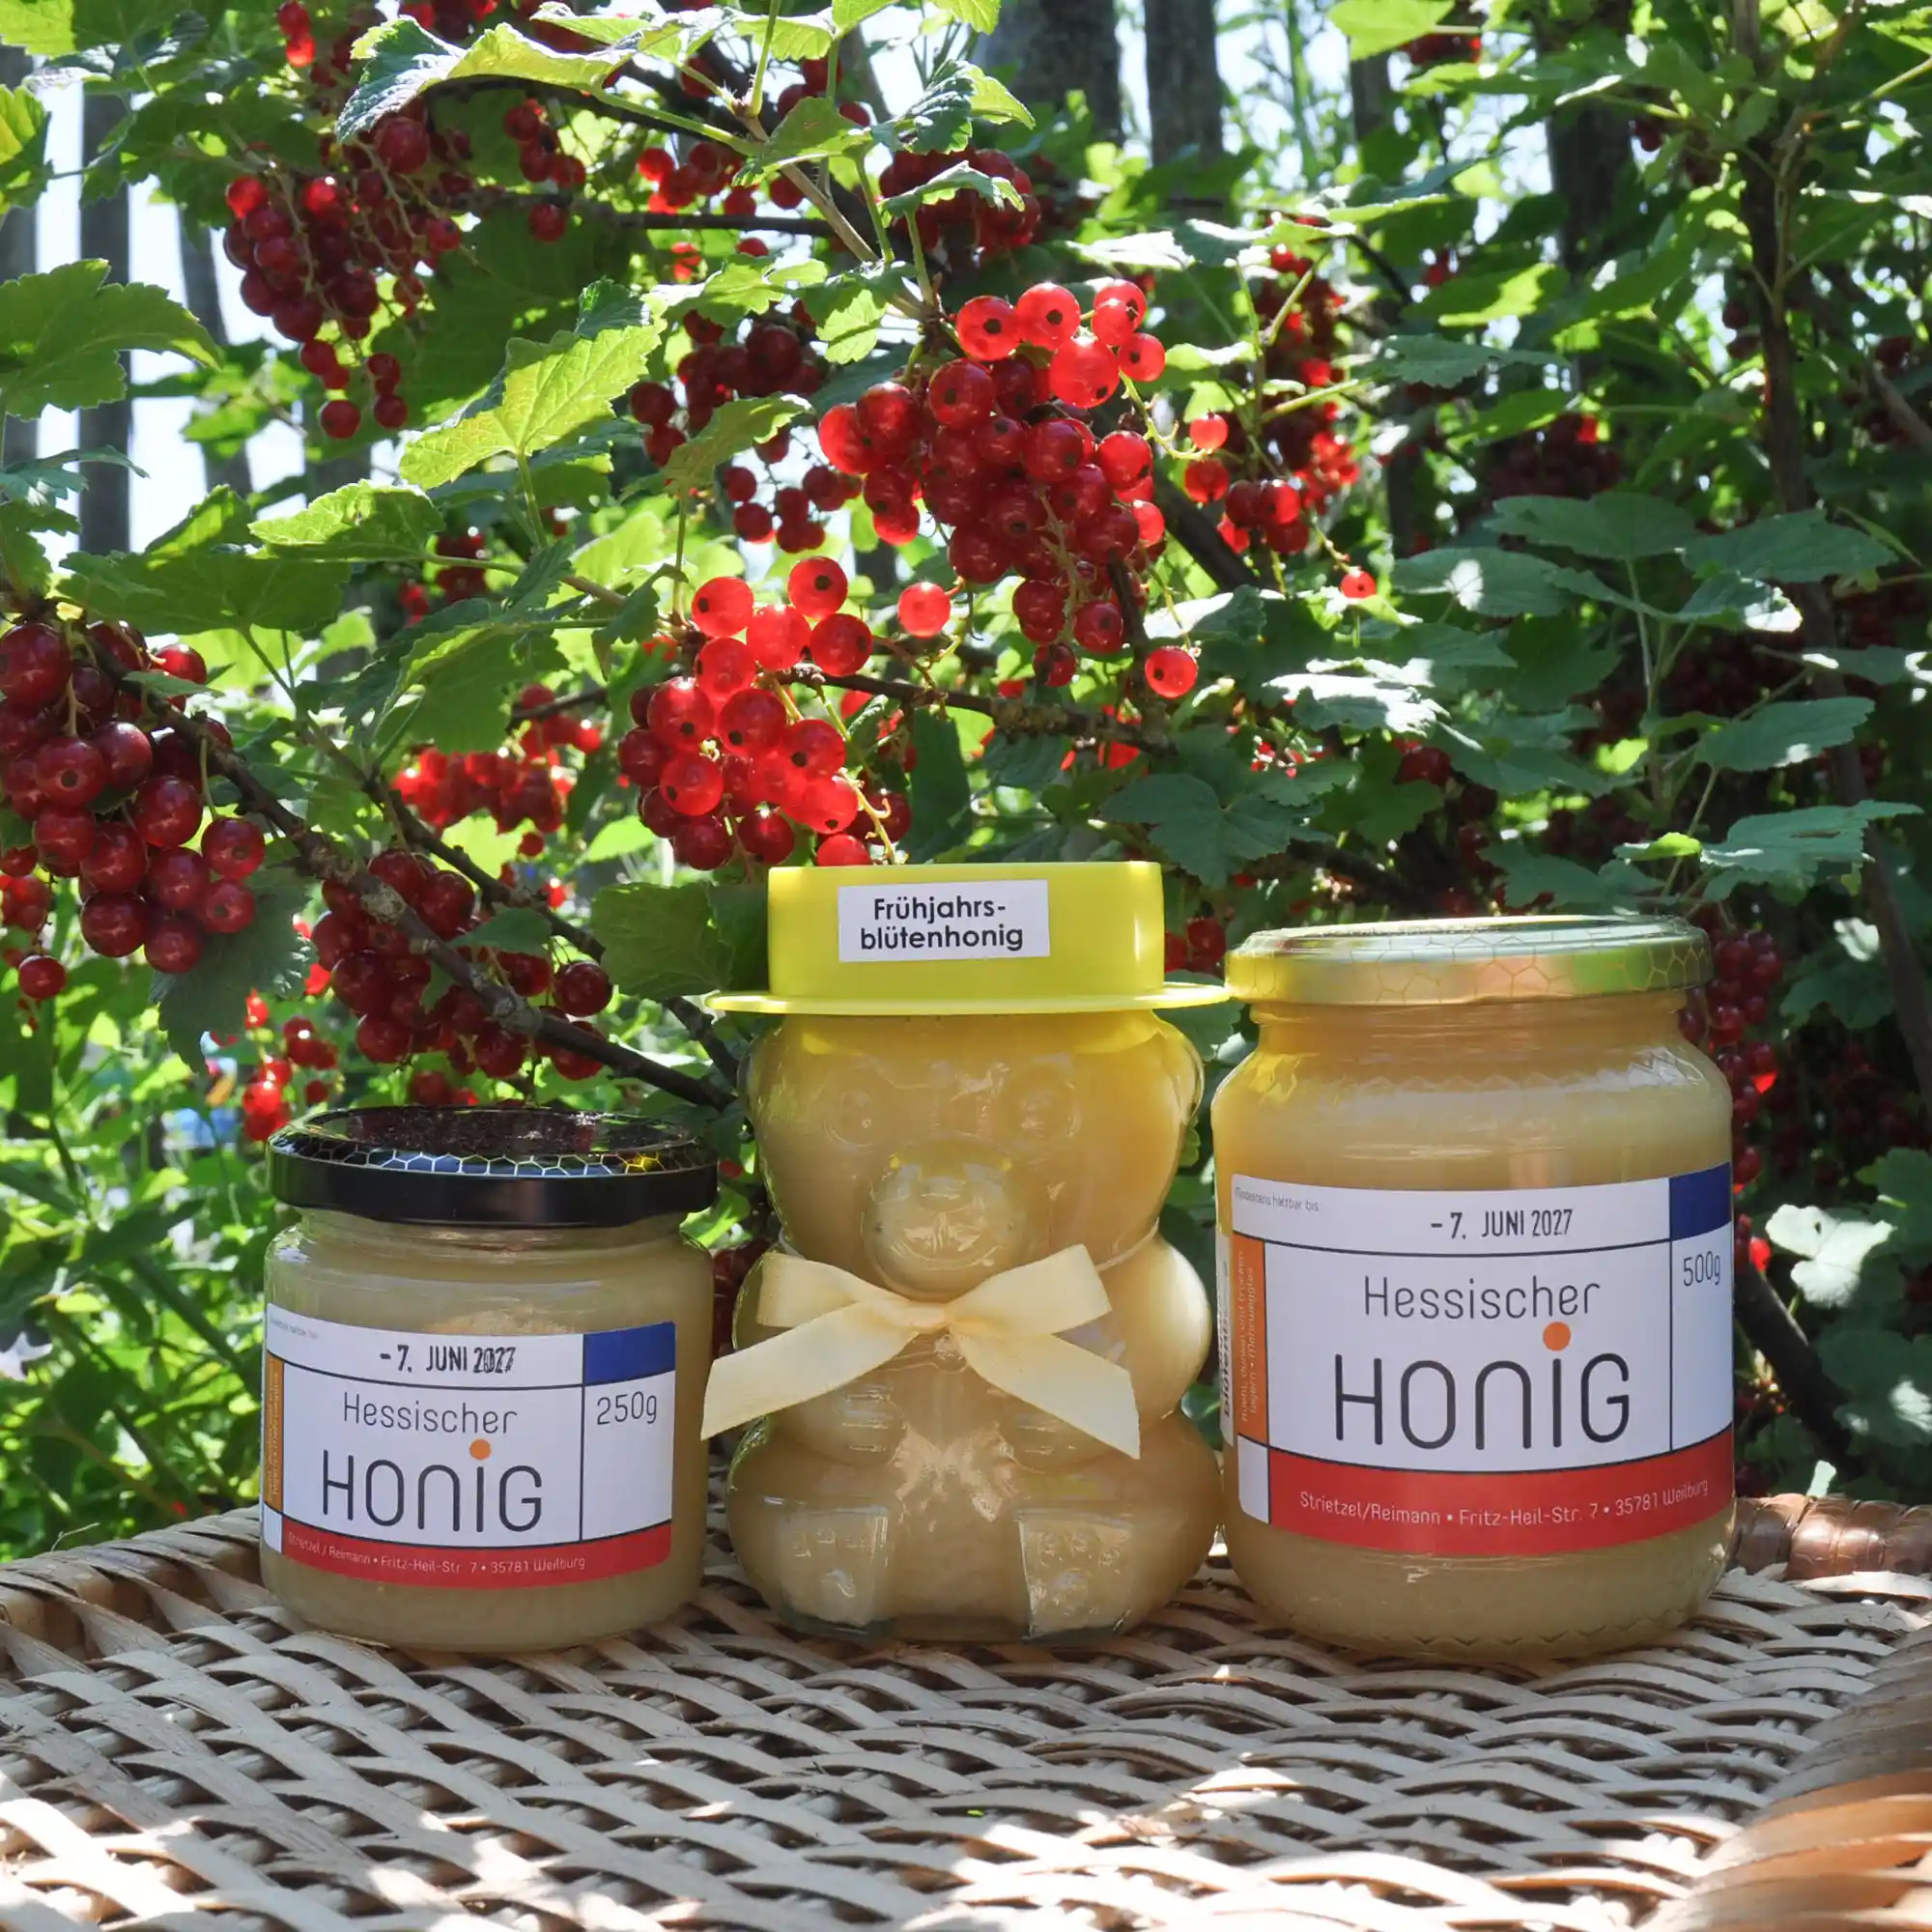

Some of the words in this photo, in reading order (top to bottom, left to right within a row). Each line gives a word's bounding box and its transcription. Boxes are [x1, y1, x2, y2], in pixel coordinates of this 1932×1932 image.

[873, 895, 1007, 924] Frühjahrs-
[860, 924, 1024, 952] blütenhonig
[1481, 1209, 1524, 1237] JUNI
[1531, 1208, 1573, 1236] 2027
[1683, 1251, 1721, 1288] 500g
[1364, 1274, 1601, 1321] Hessischer
[425, 1345, 468, 1372] JUNI
[472, 1346, 517, 1374] 2027
[343, 1391, 519, 1435] Hessischer
[596, 1391, 658, 1427] 250g
[1589, 1503, 1599, 1520] 7
[1614, 1492, 1658, 1517] 35781
[1662, 1479, 1708, 1506] Weilburg
[469, 1560, 477, 1574] 7
[490, 1560, 529, 1574] 35781
